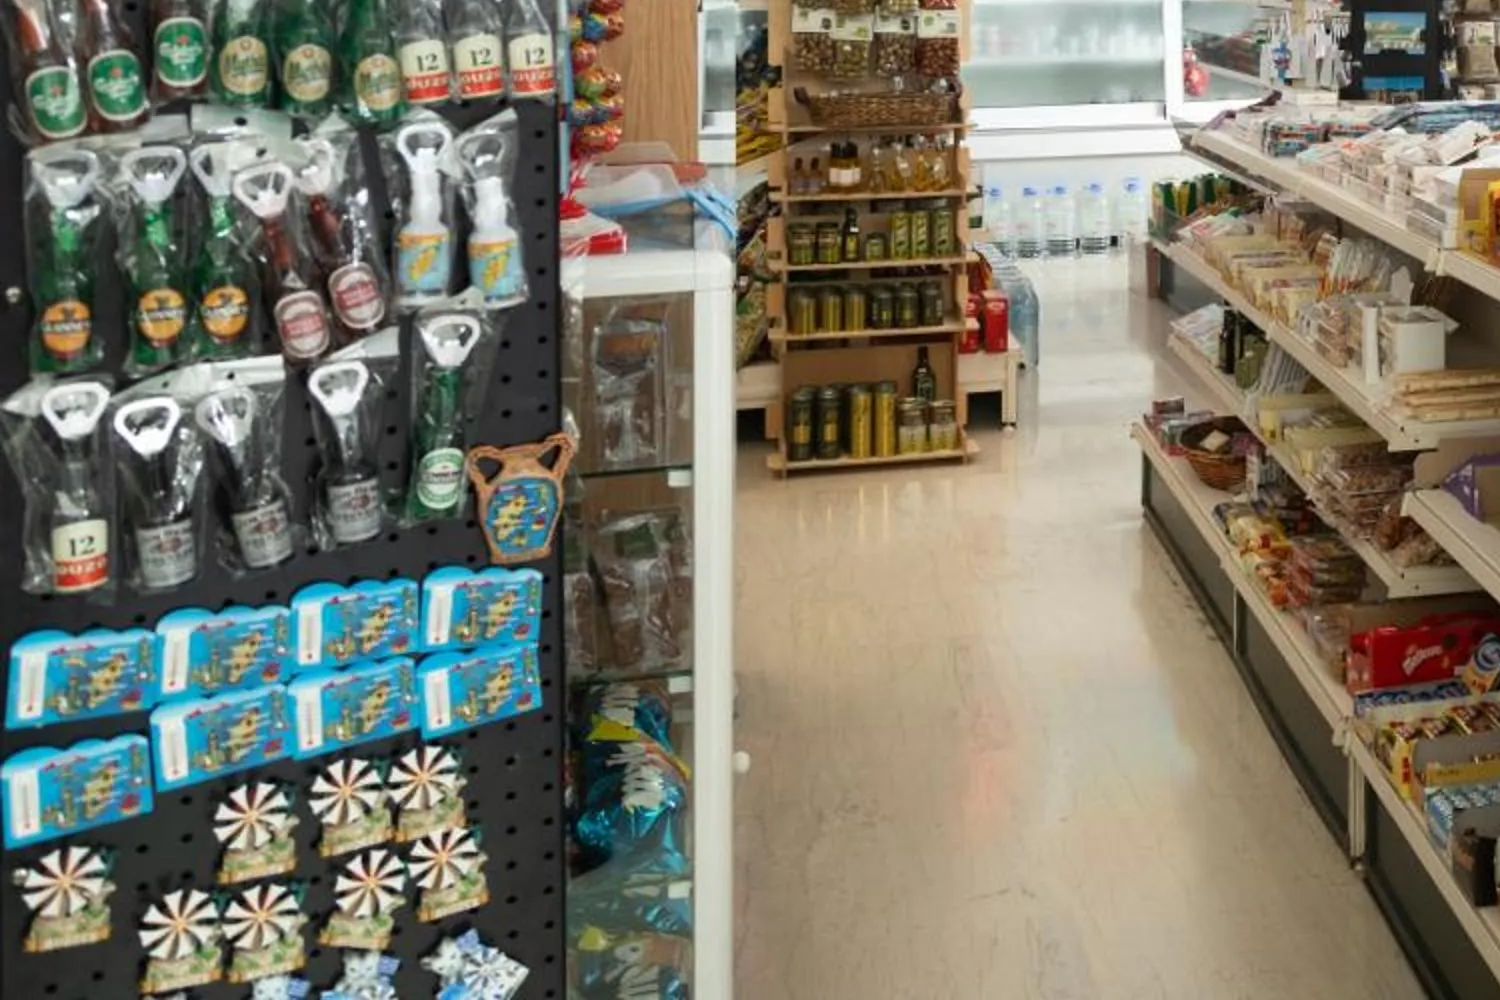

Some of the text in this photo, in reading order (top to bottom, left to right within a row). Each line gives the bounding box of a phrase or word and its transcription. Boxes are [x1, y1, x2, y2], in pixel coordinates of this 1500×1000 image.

[416, 53, 440, 72] 12
[470, 48, 492, 67] 12
[524, 47, 545, 66] 12
[69, 535, 96, 558] 12
